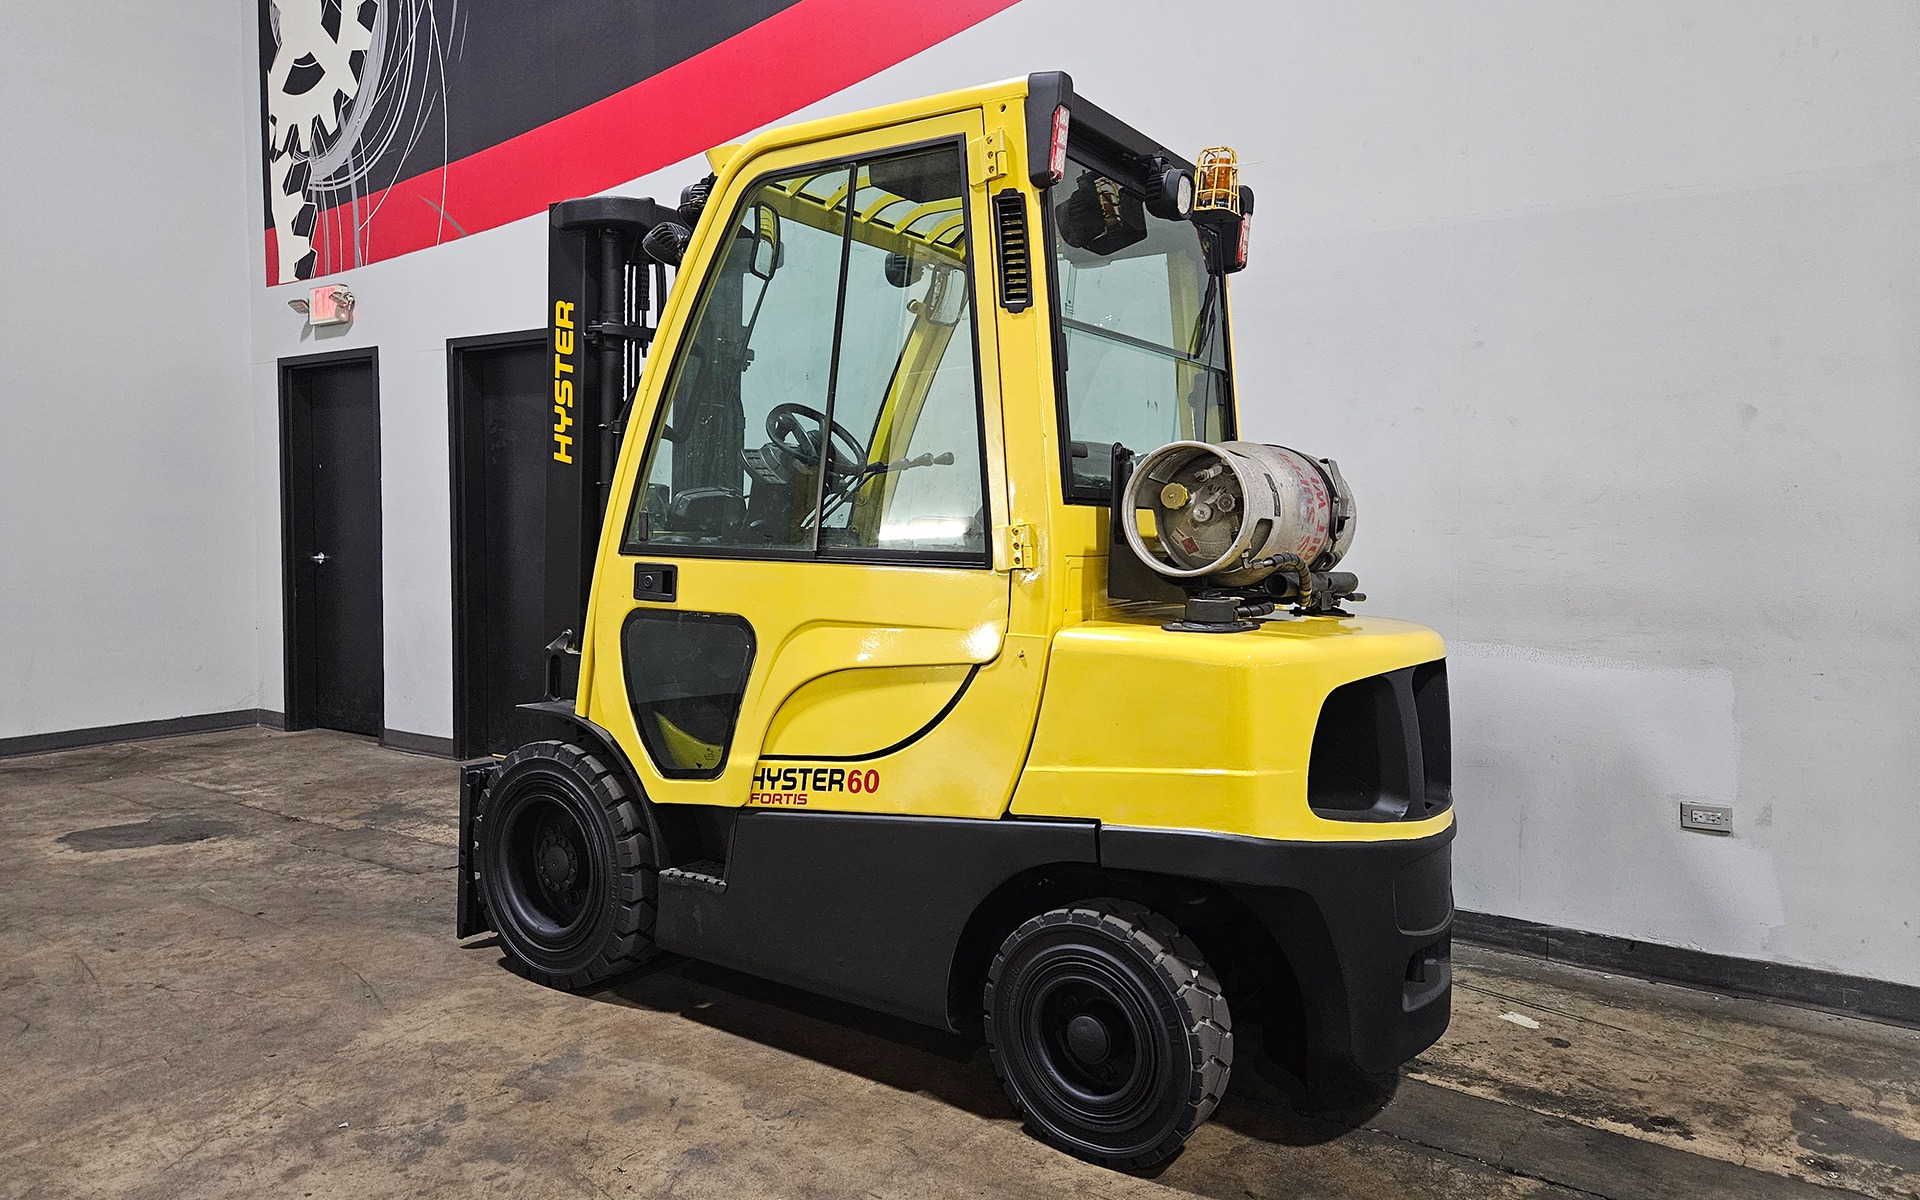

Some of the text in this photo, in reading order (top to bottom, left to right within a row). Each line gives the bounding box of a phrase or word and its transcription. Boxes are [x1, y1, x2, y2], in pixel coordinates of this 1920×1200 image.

[553, 300, 575, 465] HYSTER
[751, 767, 880, 794] HYSTER 60
[750, 793, 808, 805] FORTIS
